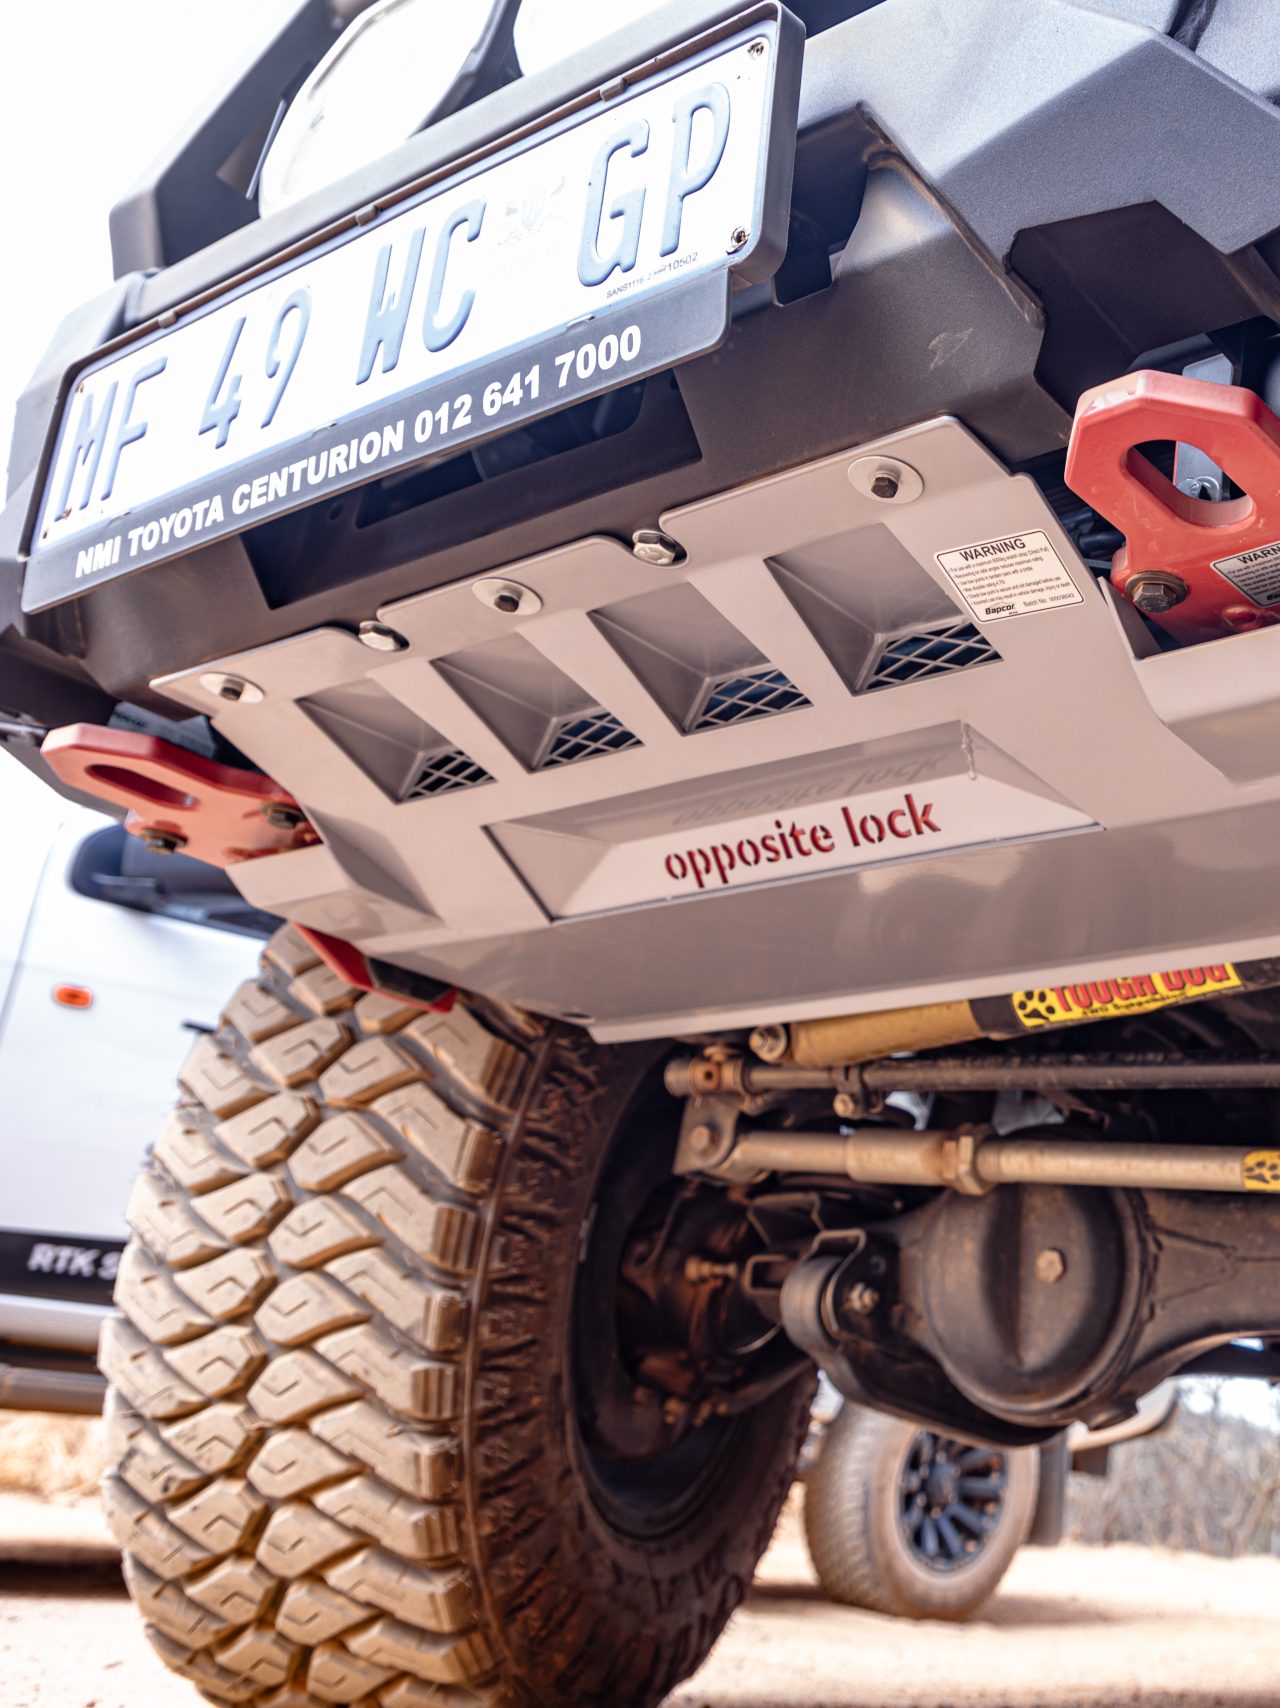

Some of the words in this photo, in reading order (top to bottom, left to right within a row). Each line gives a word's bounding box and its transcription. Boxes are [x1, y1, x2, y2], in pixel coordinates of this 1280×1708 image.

[54, 356, 168, 523] MF
[199, 285, 312, 450] 49
[356, 196, 487, 385] WC
[577, 82, 731, 287] GP
[75, 536, 121, 578] NMI
[128, 495, 224, 557] TOYOTA
[232, 420, 404, 534] CENTURION
[415, 394, 472, 443] 012
[482, 364, 540, 416] 641
[554, 325, 641, 388] 7000
[960, 538, 1026, 561] WARNING
[985, 603, 1015, 615] Bapcor
[664, 819, 835, 888] opposite
[841, 793, 941, 847] lock
[1052, 973, 1156, 1012] TOUGH
[1161, 963, 1231, 992] DOG
[27, 1243, 100, 1278] RTK
